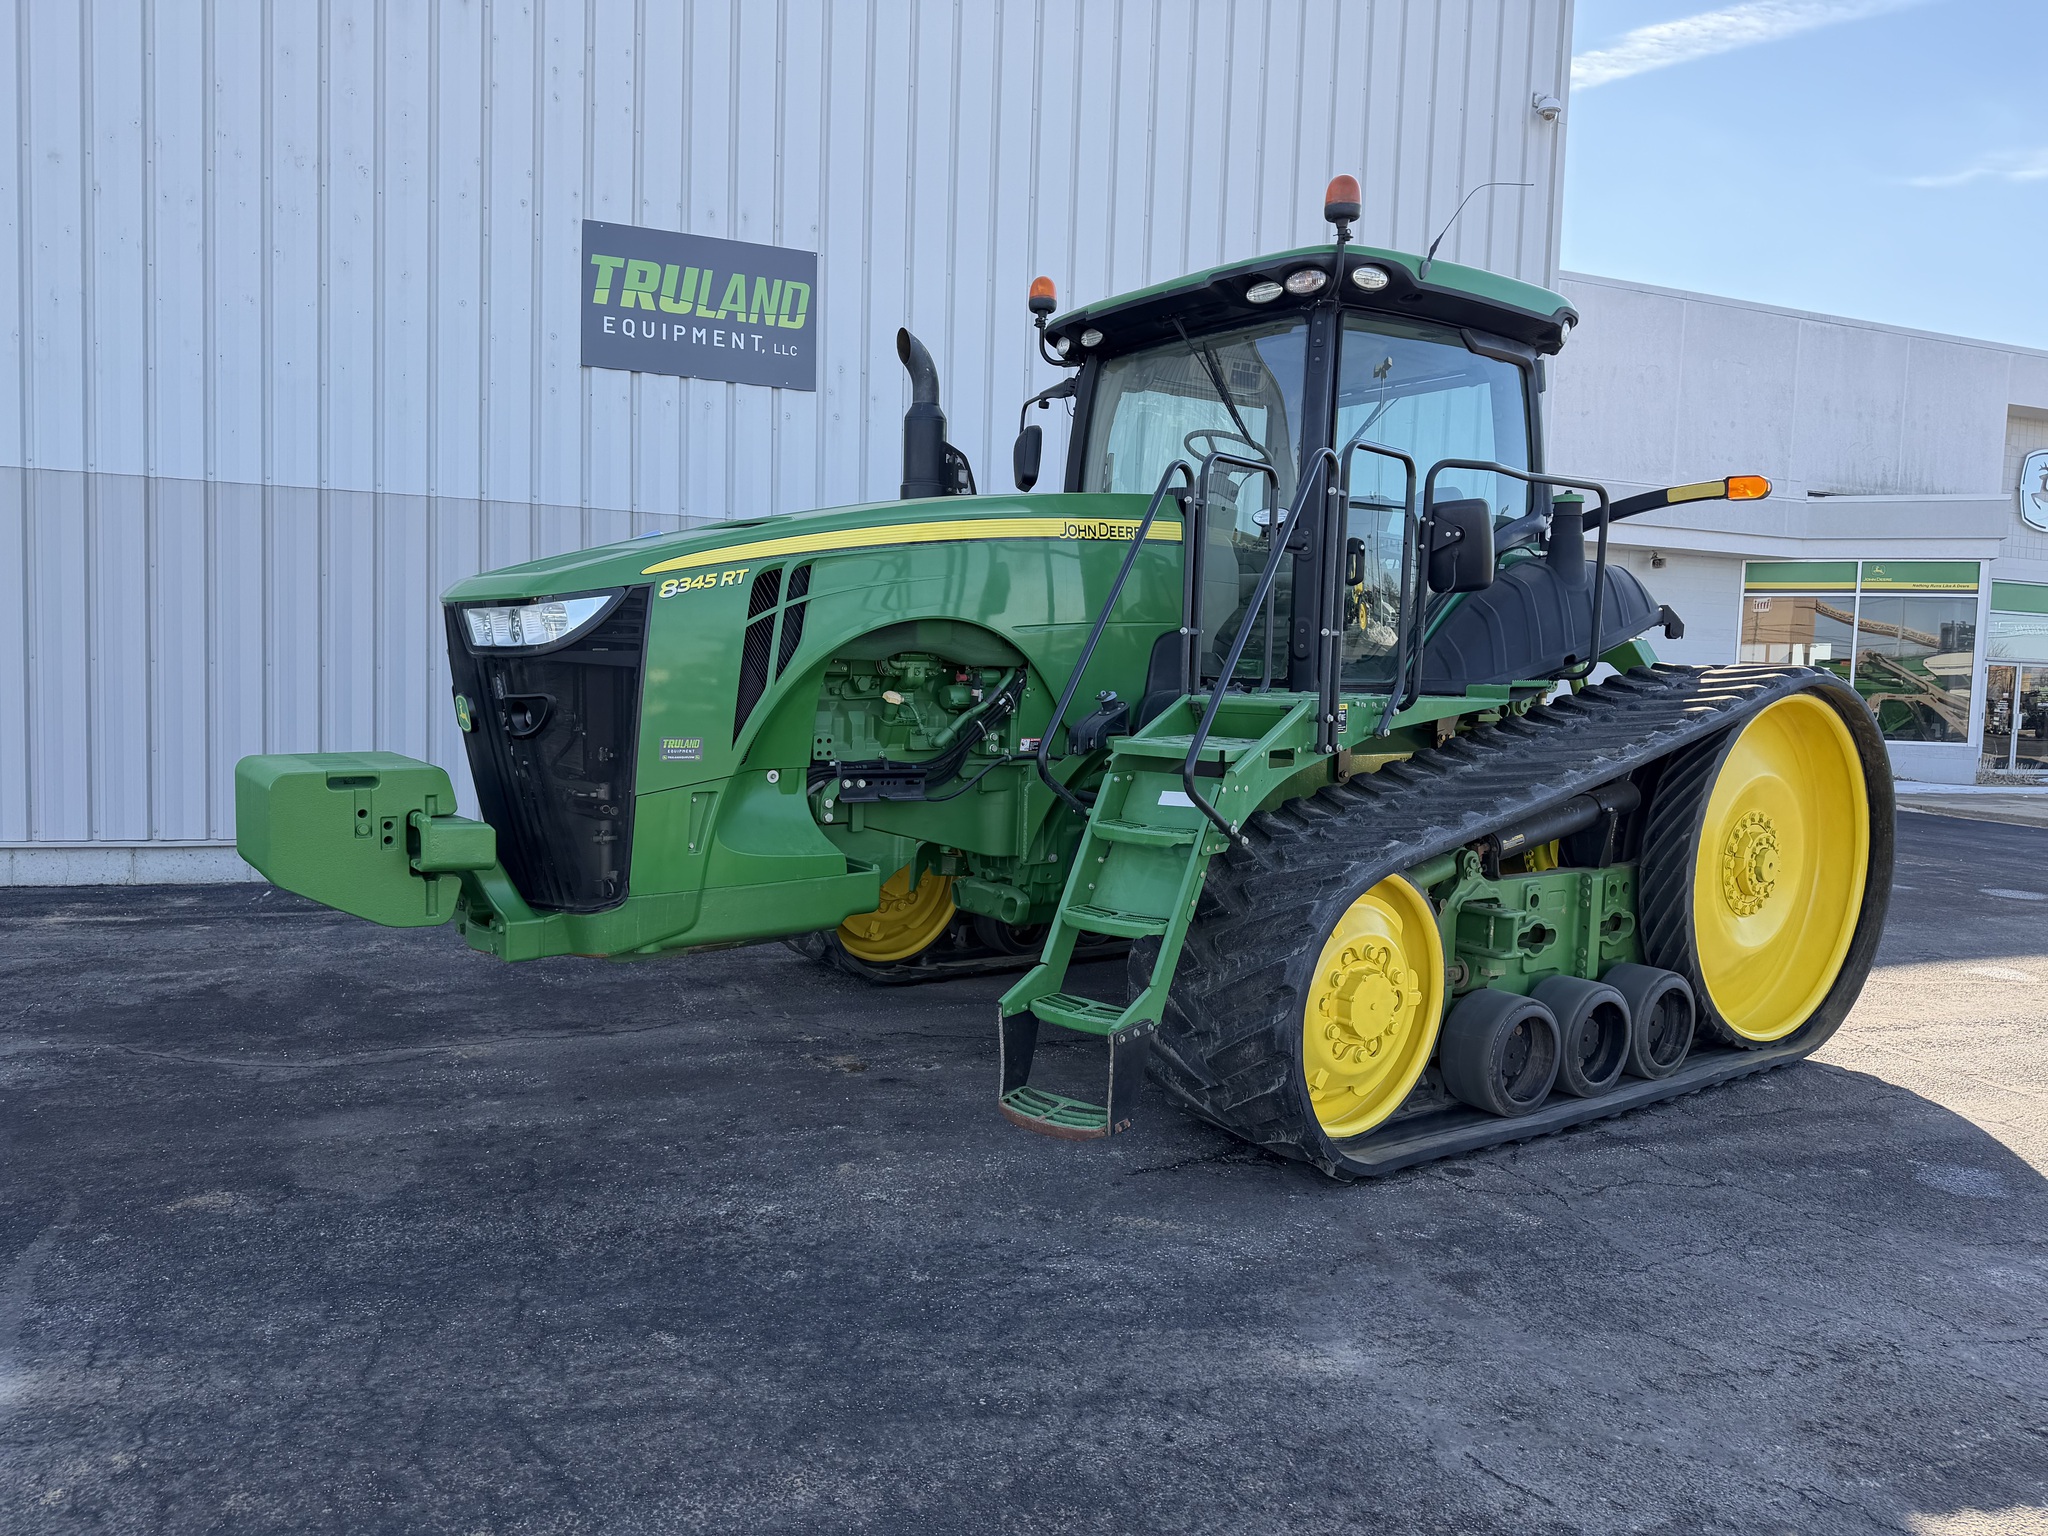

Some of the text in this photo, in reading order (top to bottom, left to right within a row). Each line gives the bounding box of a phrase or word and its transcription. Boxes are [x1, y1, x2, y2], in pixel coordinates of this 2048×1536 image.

[590, 254, 811, 330] TRULAND
[603, 315, 798, 357] EQUIPMENT, LLC
[1060, 522, 1097, 538] JOHN
[658, 568, 750, 599] 8345 RT
[663, 739, 700, 749] TRULAND
